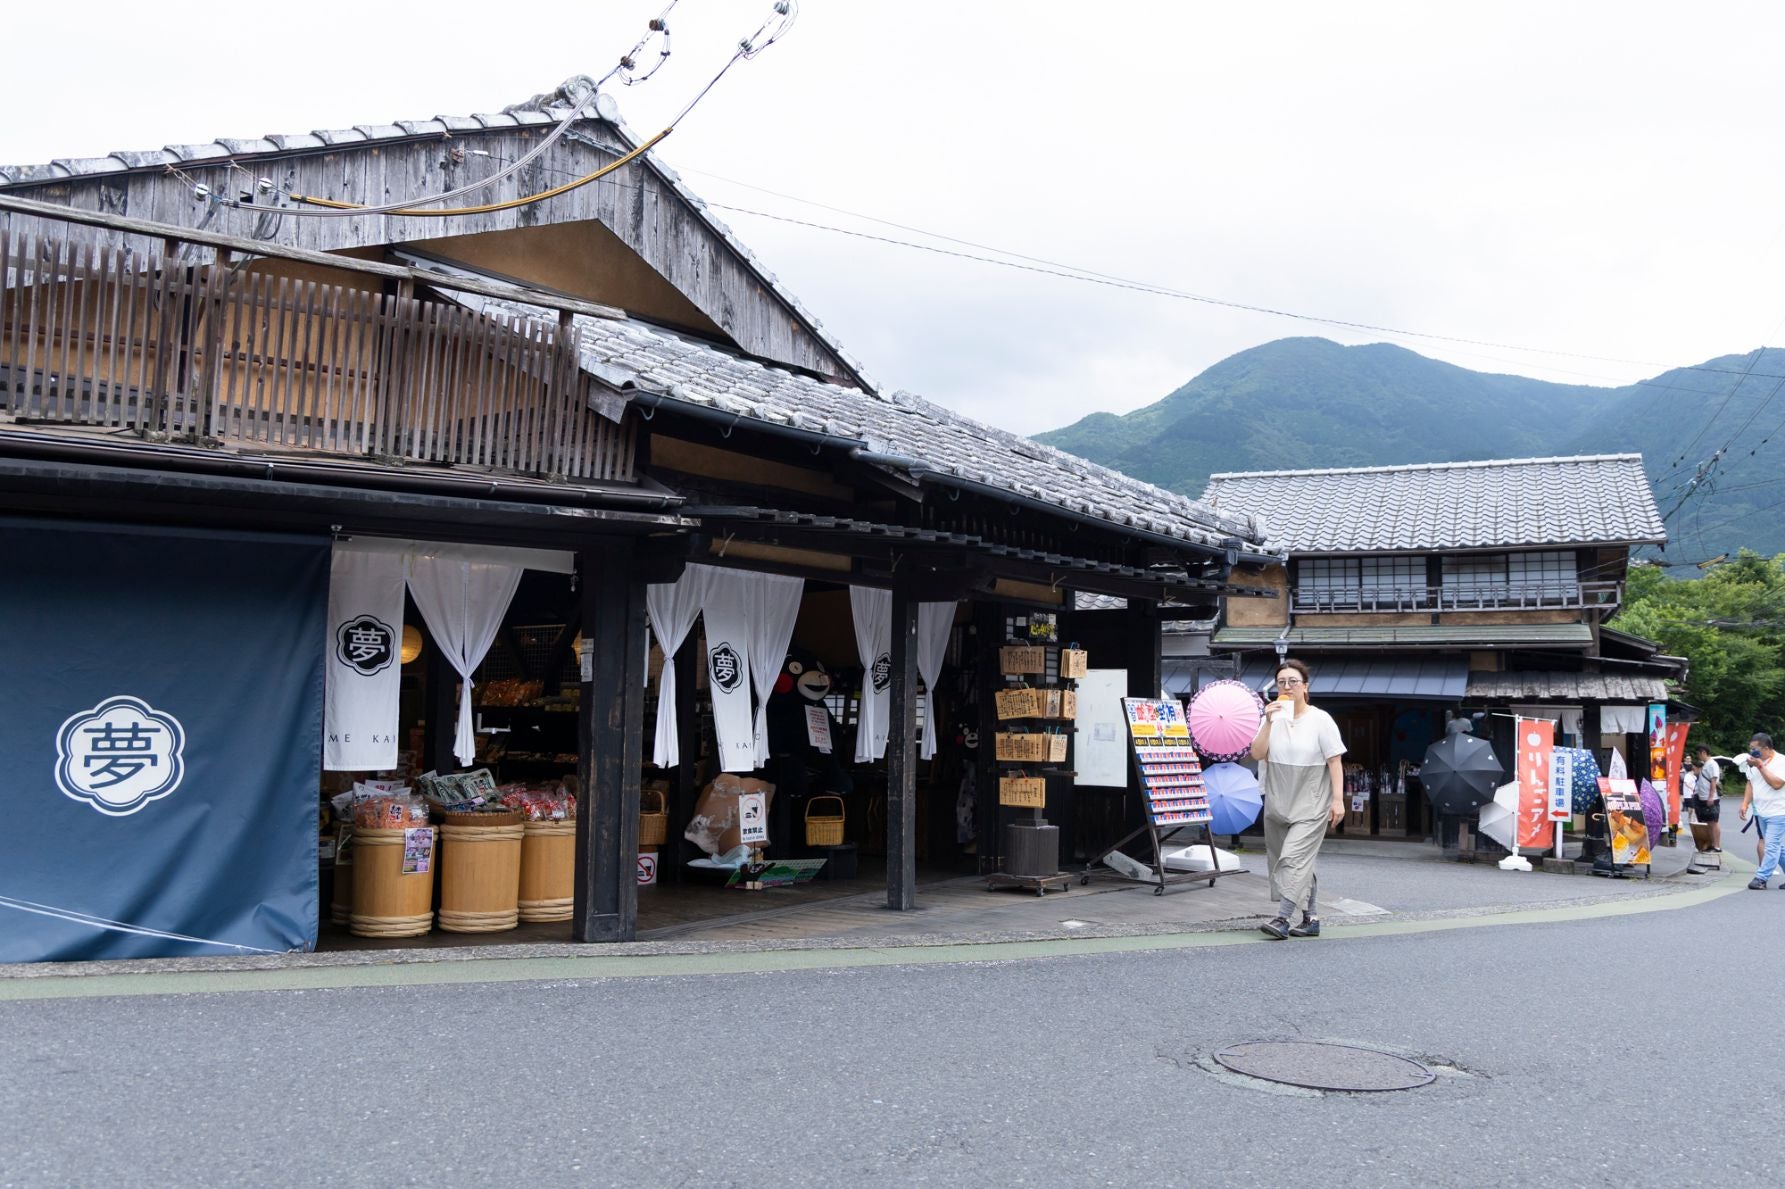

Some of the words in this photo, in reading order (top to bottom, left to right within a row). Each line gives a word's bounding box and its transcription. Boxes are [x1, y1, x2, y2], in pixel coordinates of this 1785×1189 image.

[349, 627, 386, 662] 夢
[714, 652, 735, 683] 夢
[83, 721, 162, 790] 夢
[1528, 752, 1547, 837] りんごアメ
[1555, 756, 1565, 807] 有料駐車場
